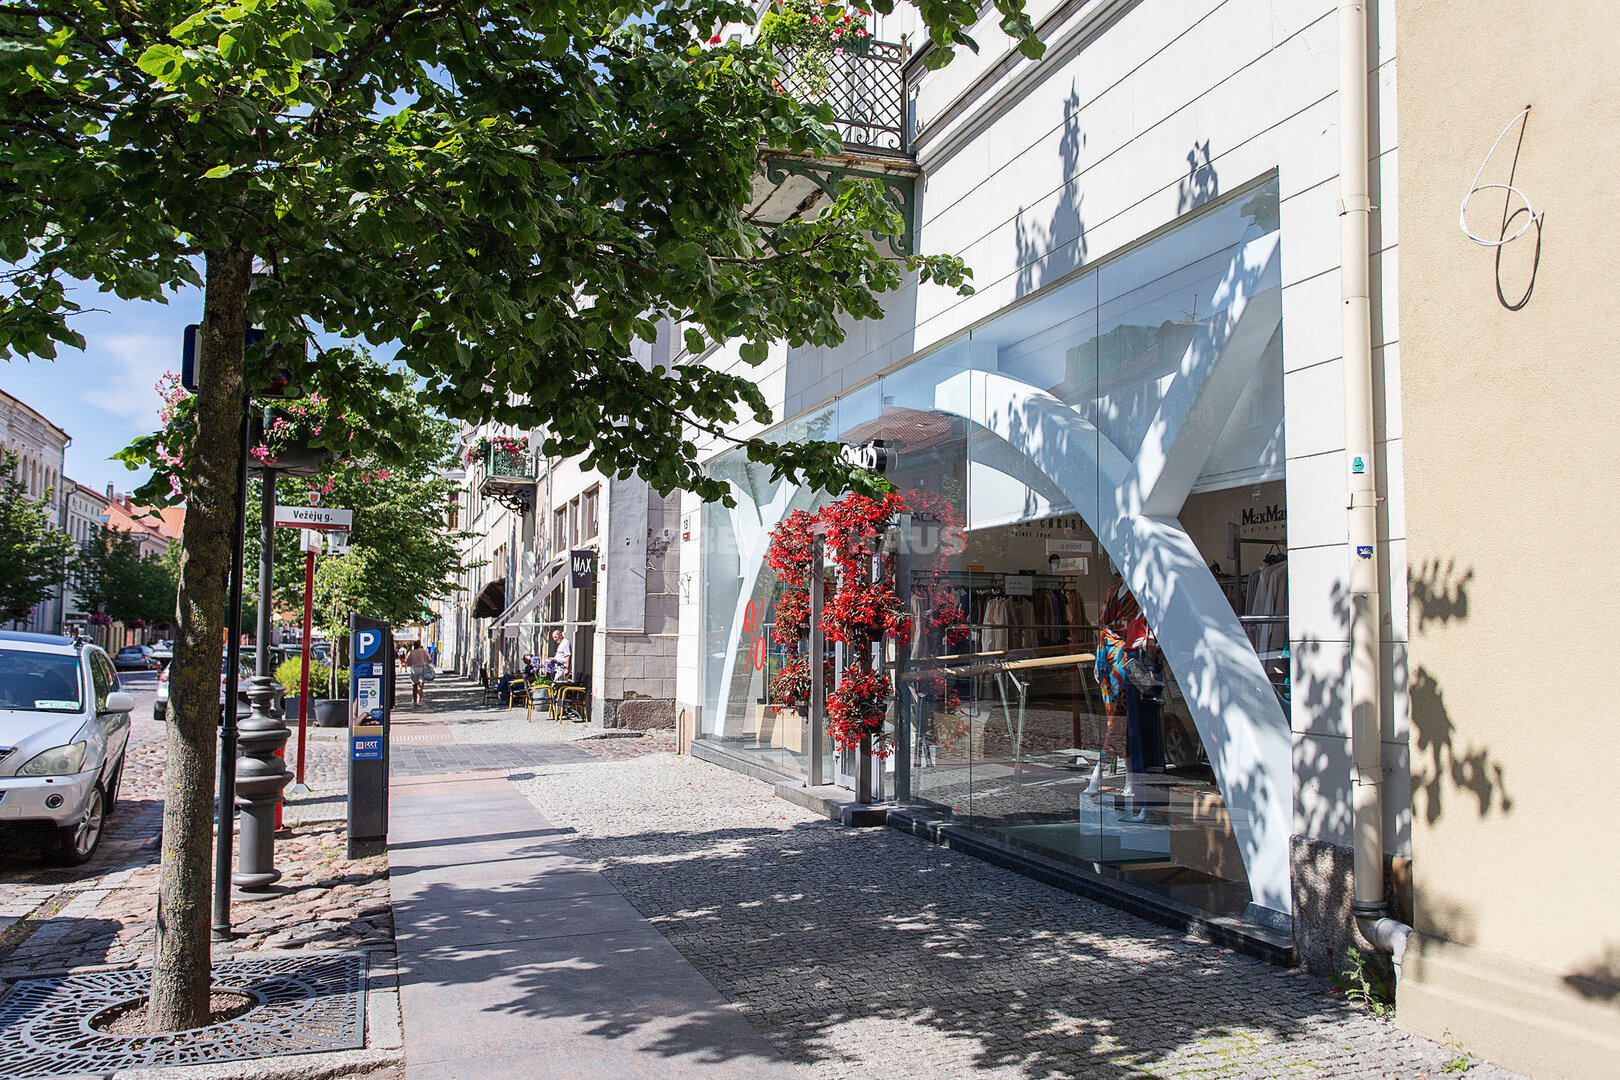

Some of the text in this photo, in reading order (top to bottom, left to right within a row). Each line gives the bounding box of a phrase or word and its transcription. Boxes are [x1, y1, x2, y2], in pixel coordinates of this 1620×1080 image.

[293, 510, 333, 523] Vežėjų g.
[573, 556, 592, 573] MAX
[360, 632, 374, 654] P
[743, 596, 766, 673] %
